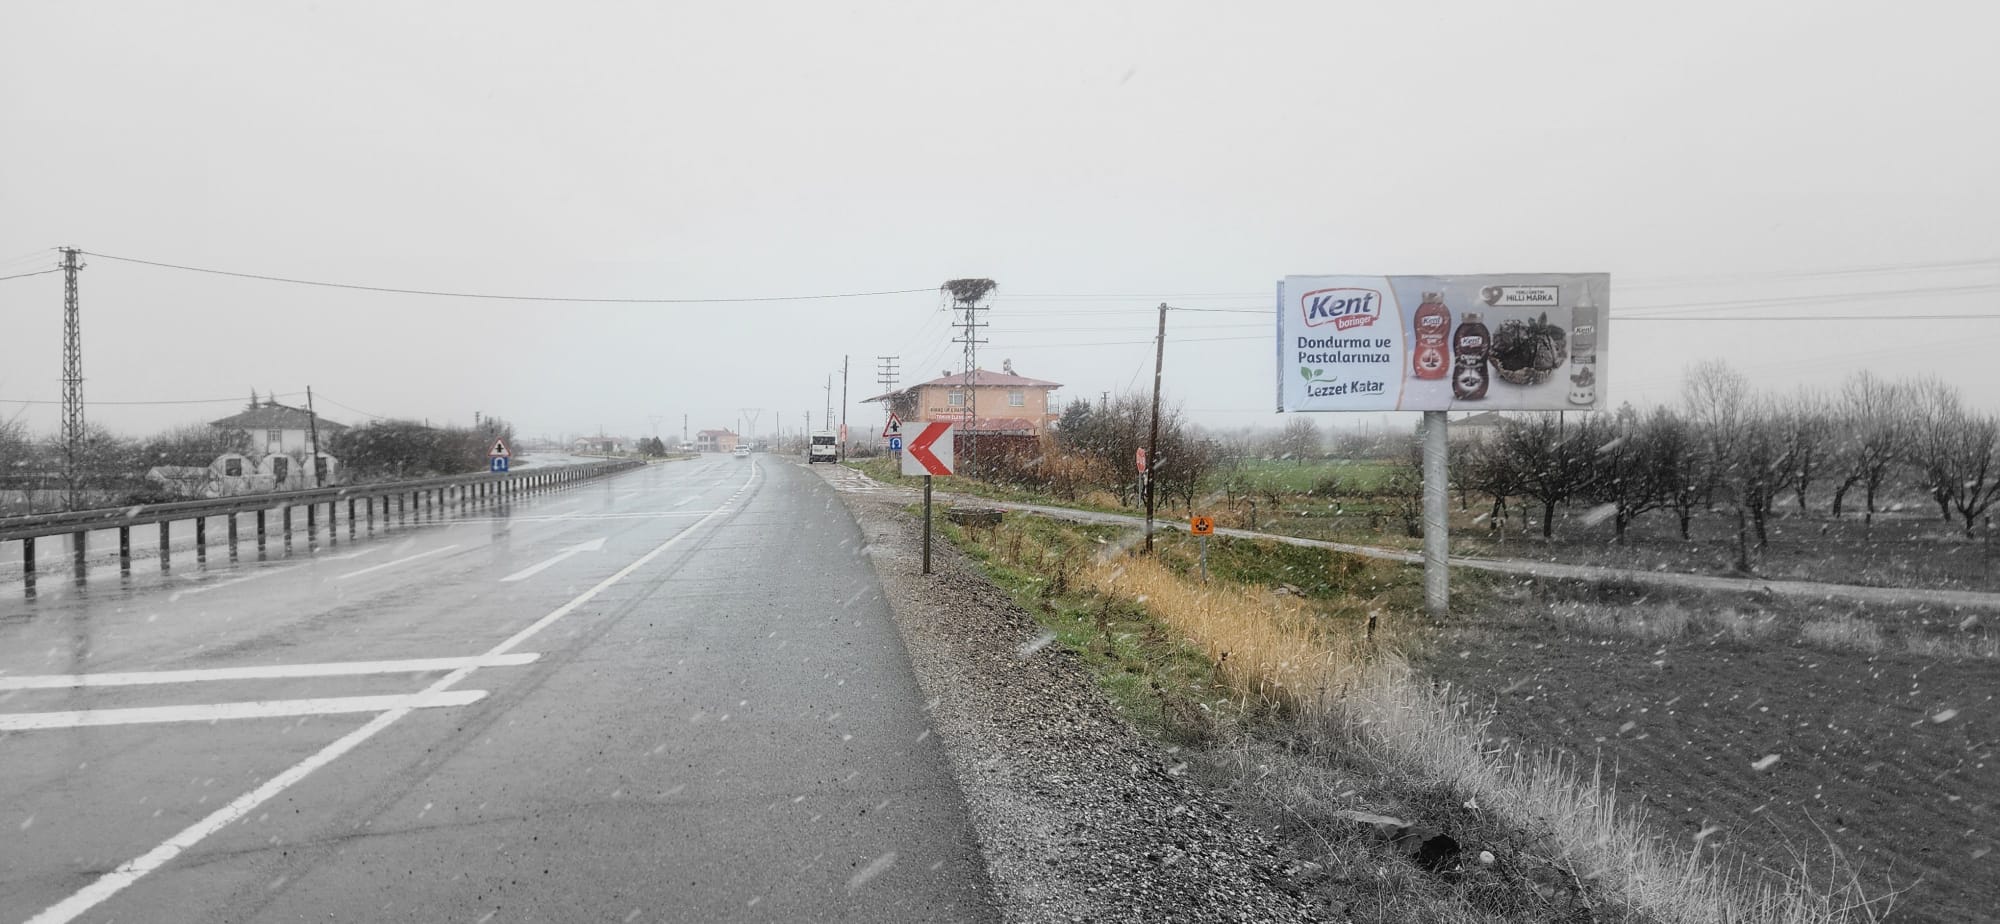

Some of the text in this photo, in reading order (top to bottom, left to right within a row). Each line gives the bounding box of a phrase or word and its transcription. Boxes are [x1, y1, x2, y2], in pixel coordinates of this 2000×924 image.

[1526, 293, 1553, 302] MARKA
[1309, 293, 1374, 320] Kent
[1338, 316, 1372, 329] boringer
[1298, 336, 1392, 349] Dondurma ve
[1298, 351, 1390, 364] Pastalarınıza
[1307, 380, 1385, 397] Lezzet Katar
